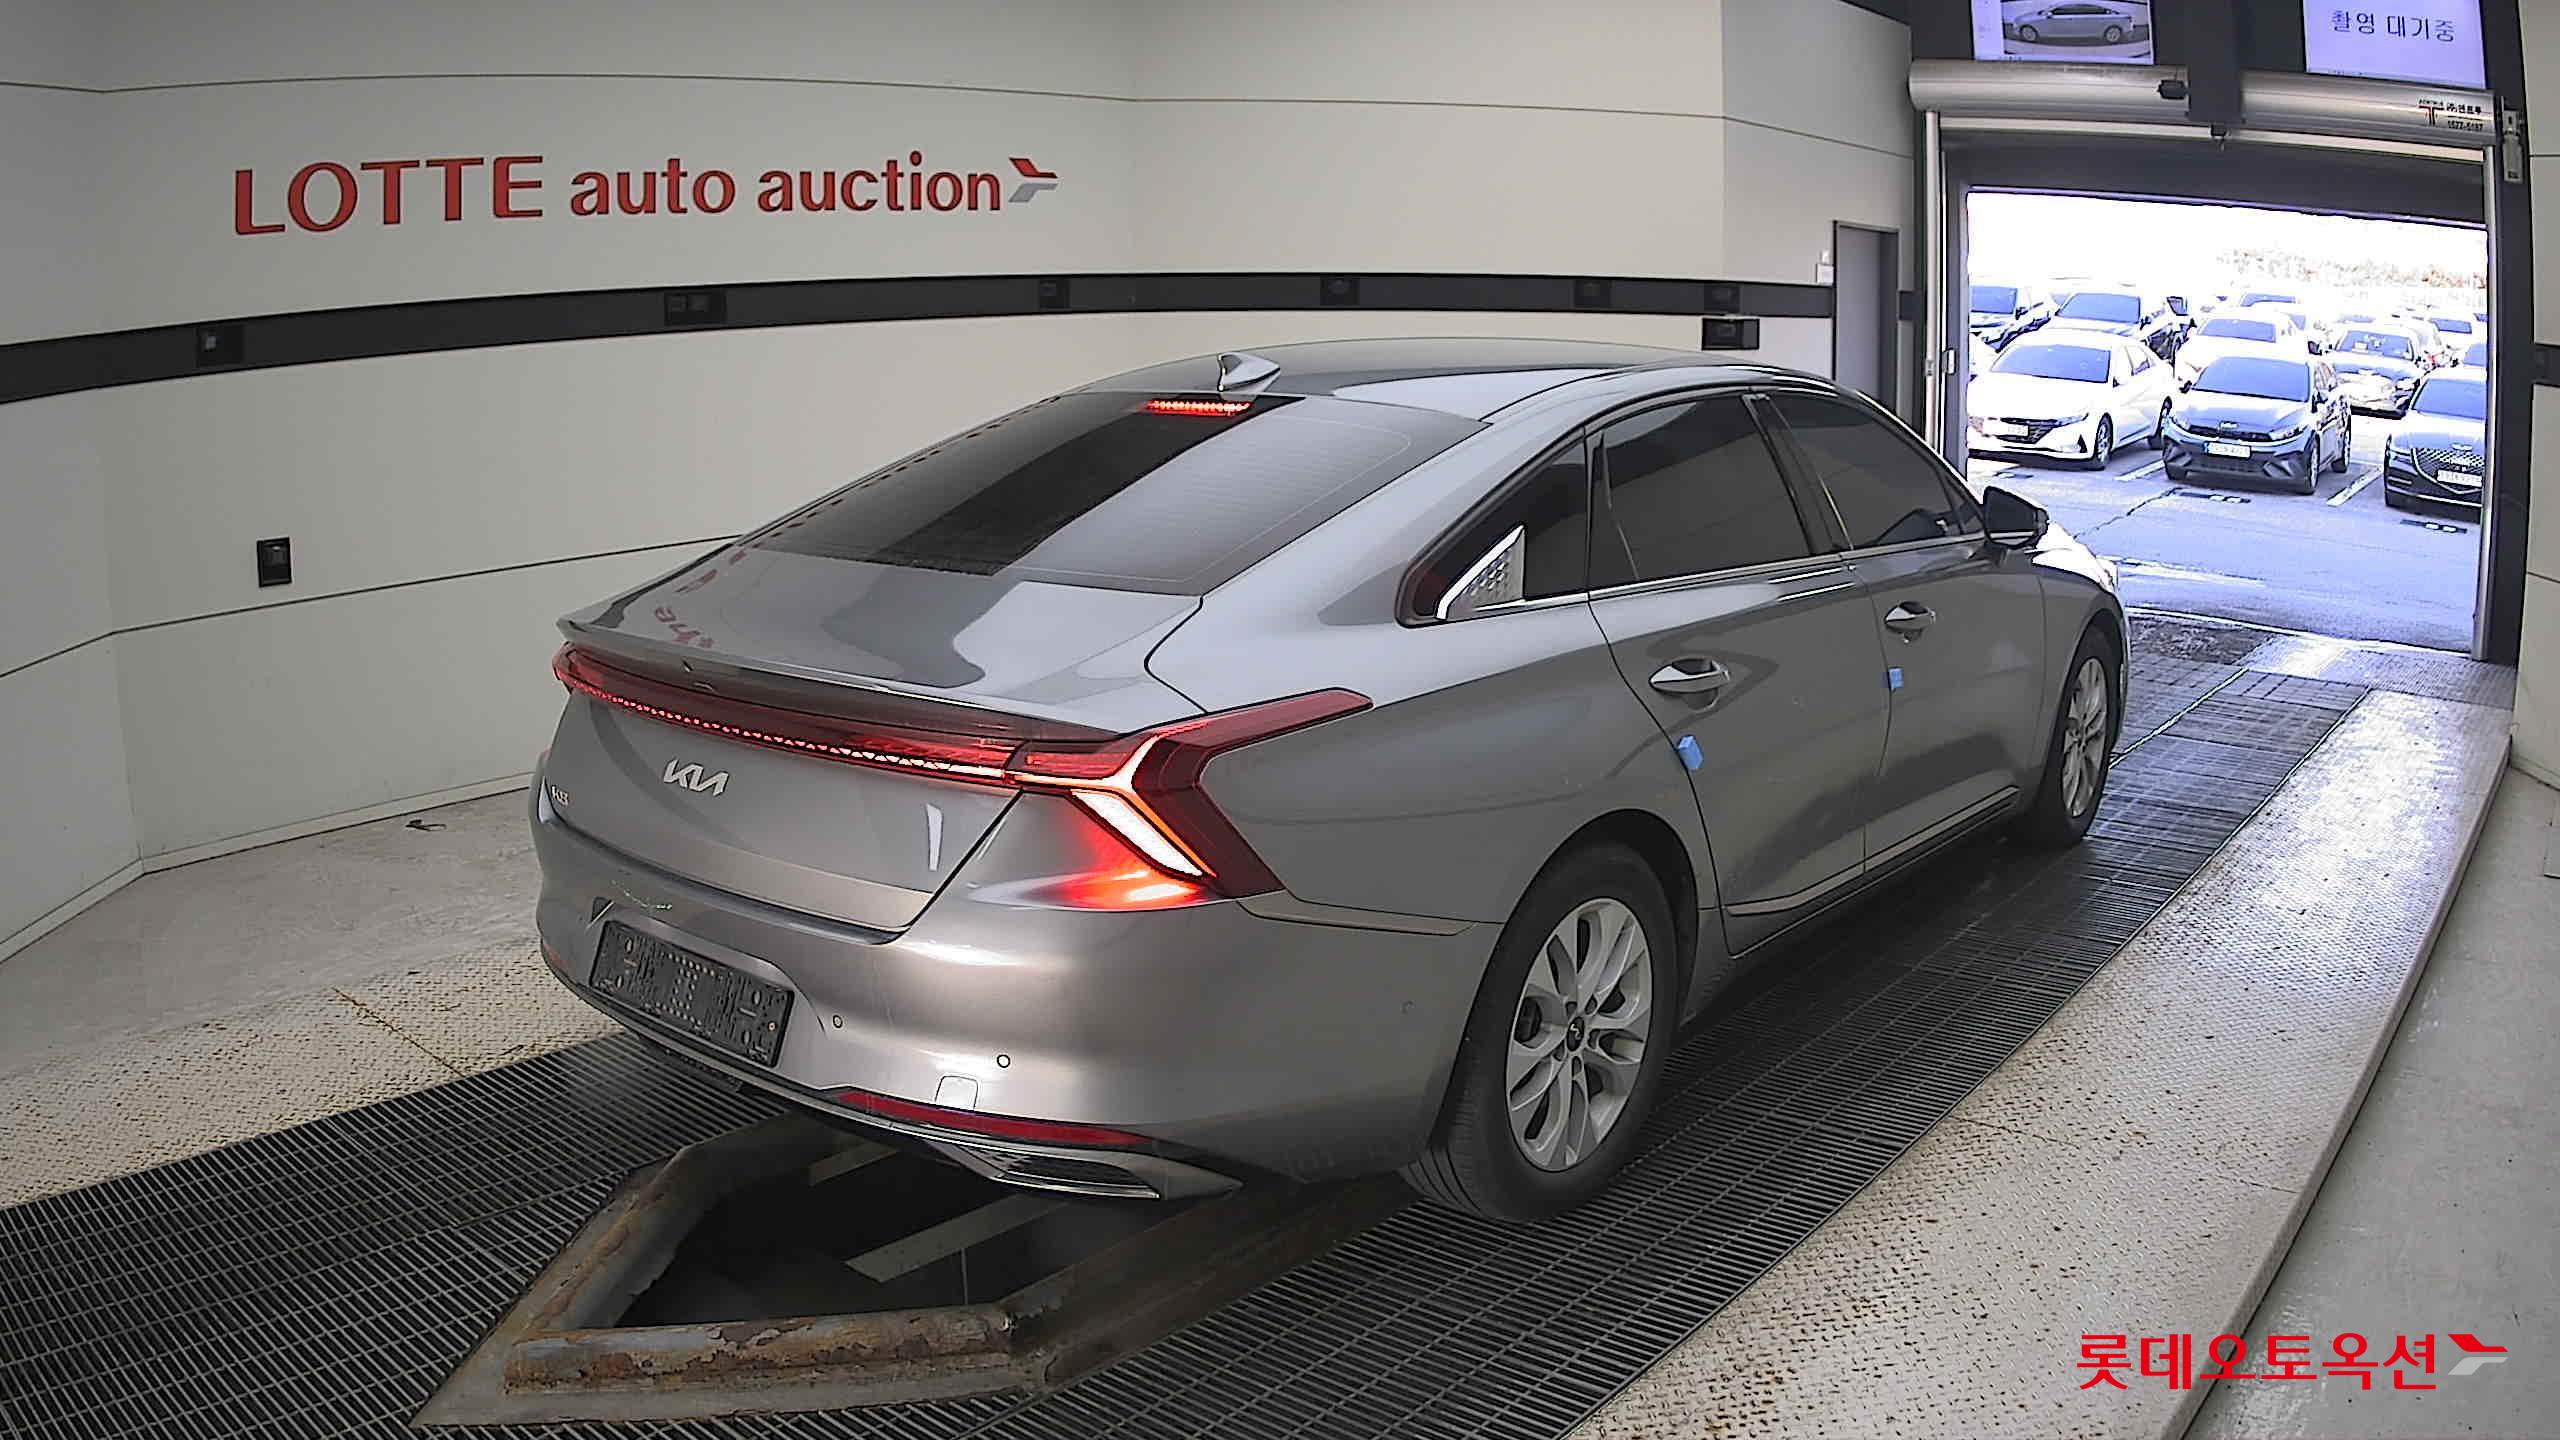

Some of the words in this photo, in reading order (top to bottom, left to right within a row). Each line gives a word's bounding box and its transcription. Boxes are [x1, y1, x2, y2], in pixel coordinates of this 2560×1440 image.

[2332, 10, 2375, 35] 촬영
[2387, 15, 2455, 43] 대기중
[235, 155, 543, 236] LOTTE
[570, 158, 736, 216] auto
[757, 150, 1002, 213] auction
[663, 759, 729, 796] KIA
